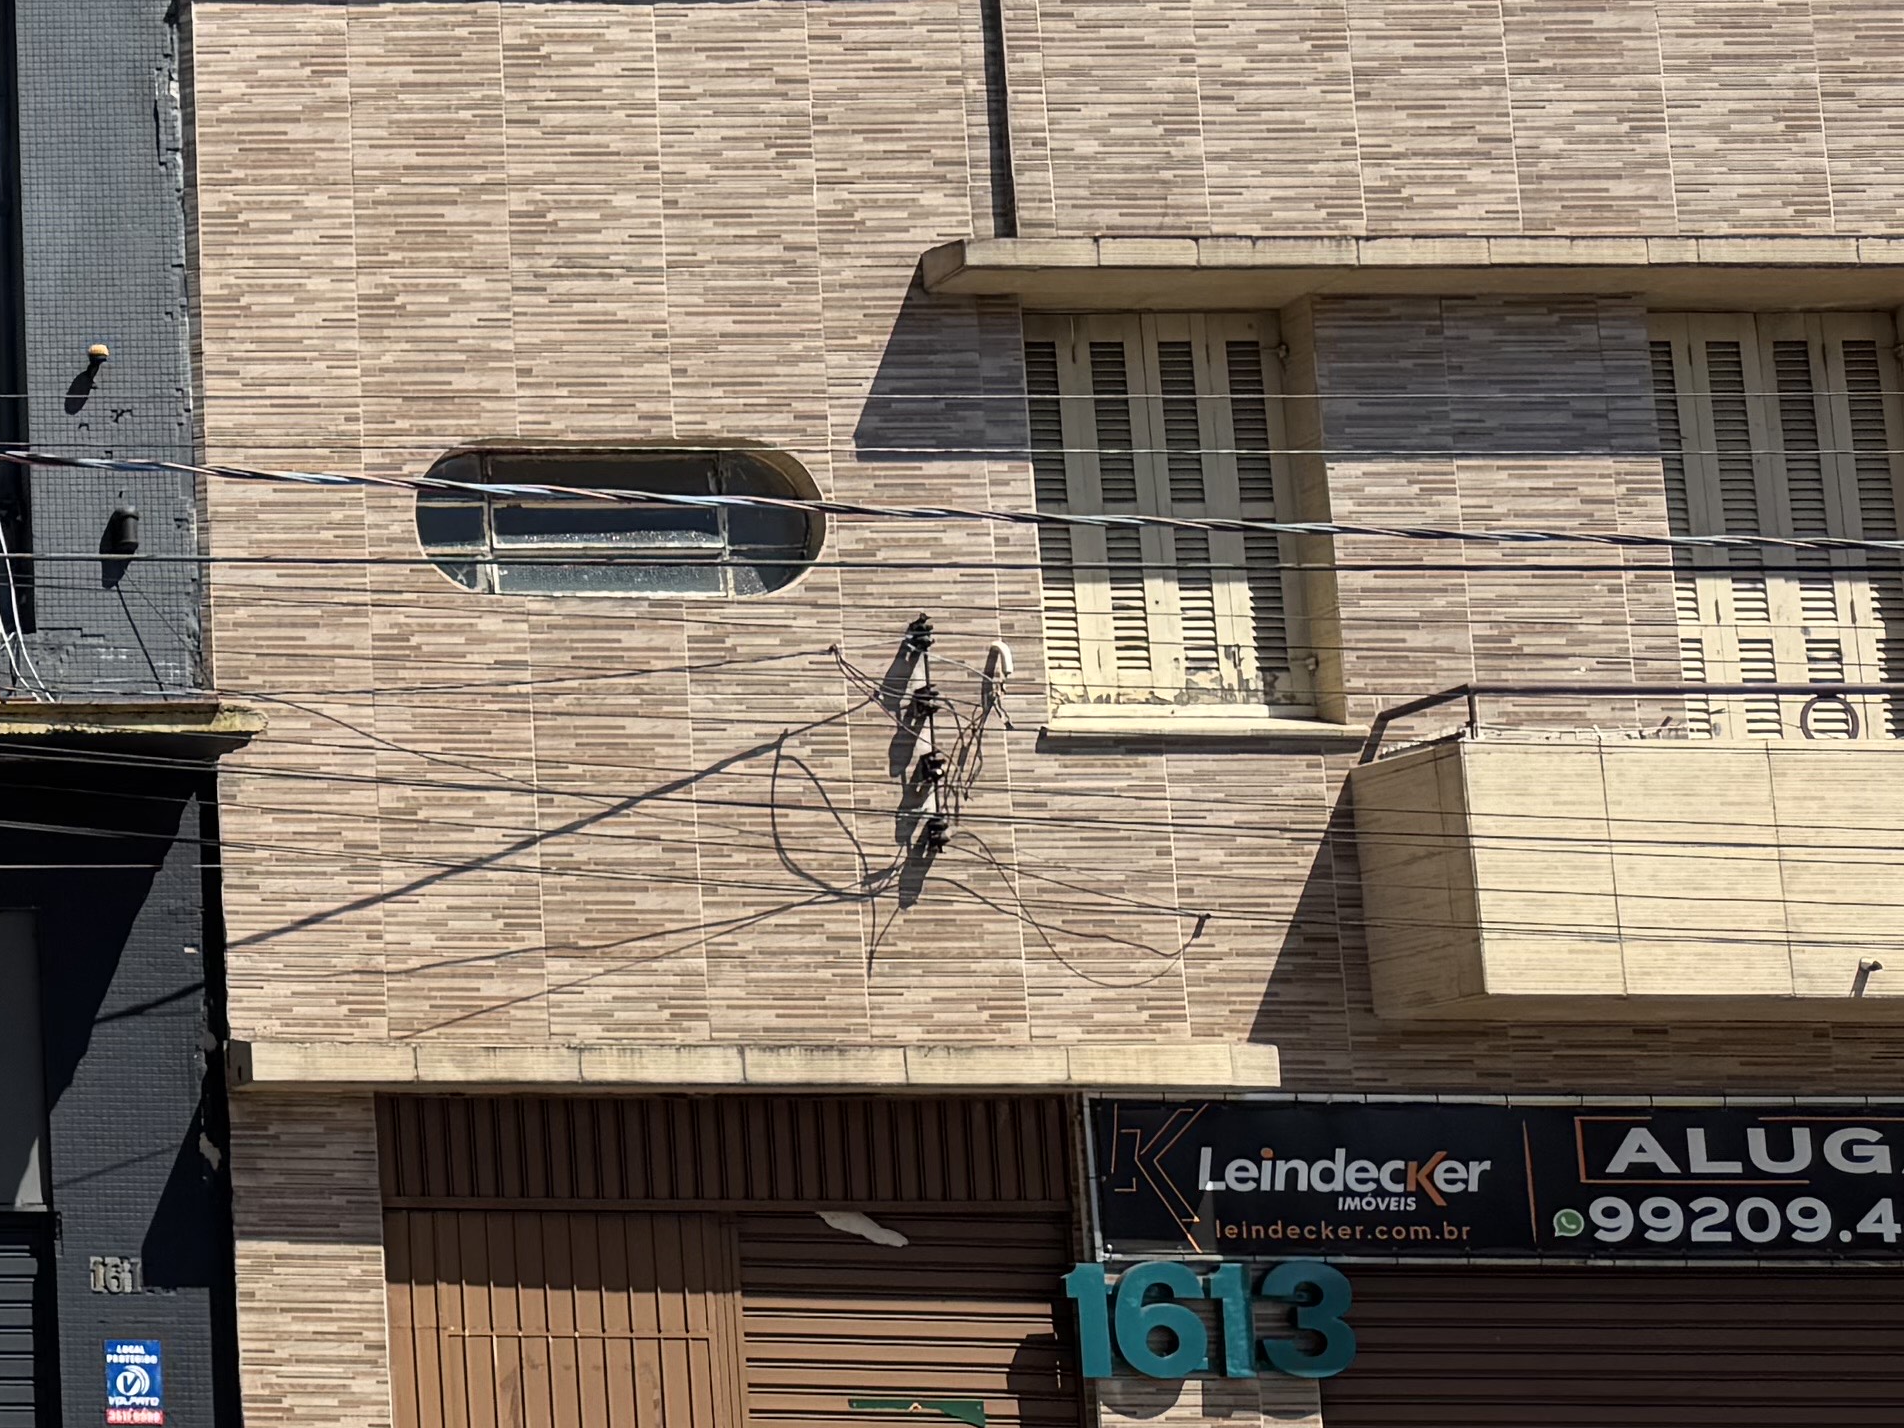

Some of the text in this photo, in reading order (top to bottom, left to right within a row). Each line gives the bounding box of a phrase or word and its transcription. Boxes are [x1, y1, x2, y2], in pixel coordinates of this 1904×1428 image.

[1605, 1127, 1904, 1174] ALUG
[1337, 1192, 1417, 1212] IMÓVEIS
[1588, 1196, 1903, 1243] 99209.4
[1215, 1219, 1472, 1241] leindecker.com.br
[1063, 1260, 1356, 1379] 1613
